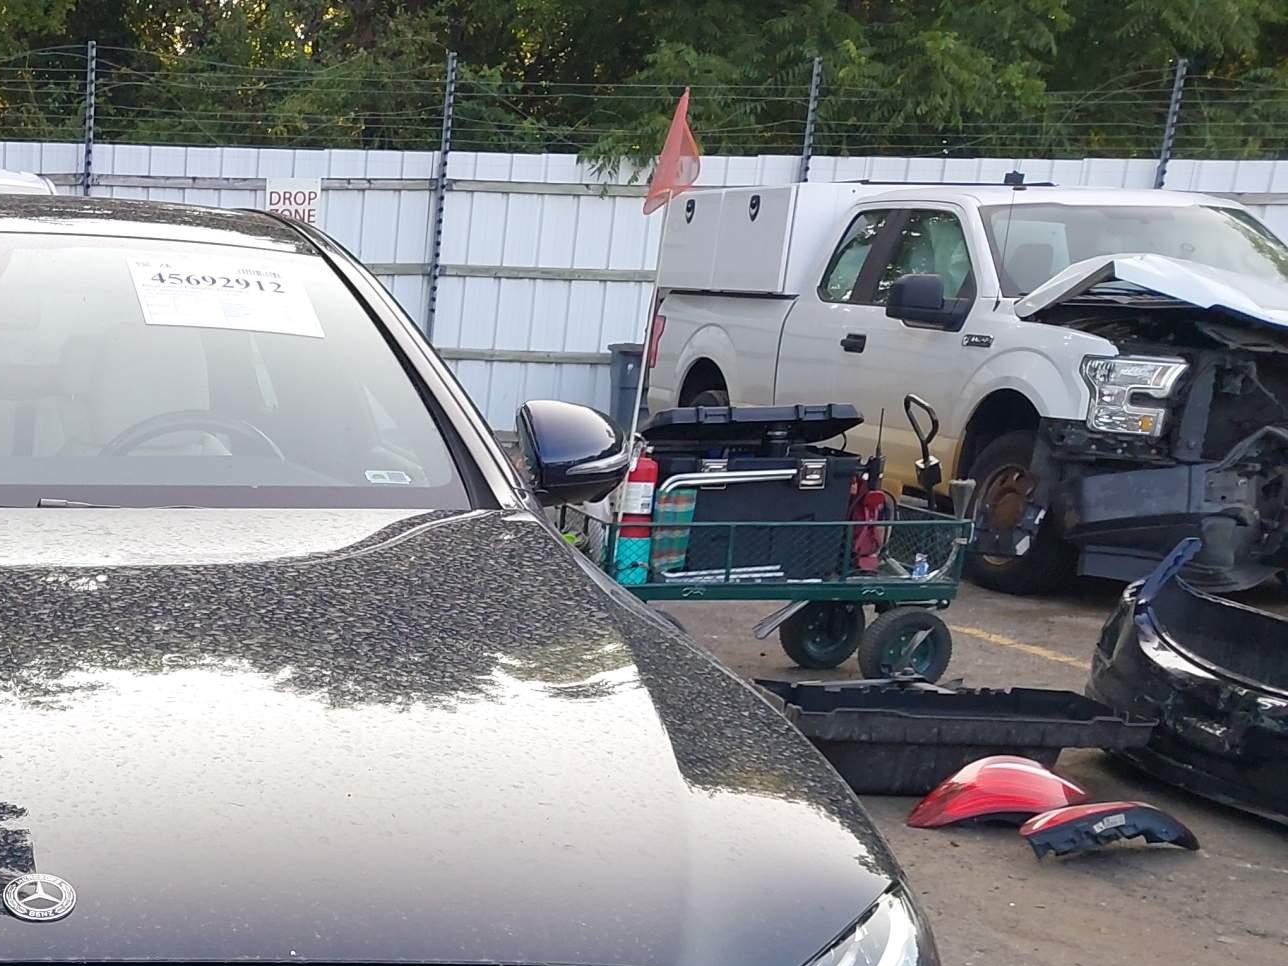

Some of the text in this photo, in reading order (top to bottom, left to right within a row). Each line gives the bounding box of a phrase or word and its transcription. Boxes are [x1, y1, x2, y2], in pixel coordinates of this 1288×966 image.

[269, 191, 318, 206] DROP
[269, 208, 317, 224] ONE
[150, 272, 286, 294] 45692912
